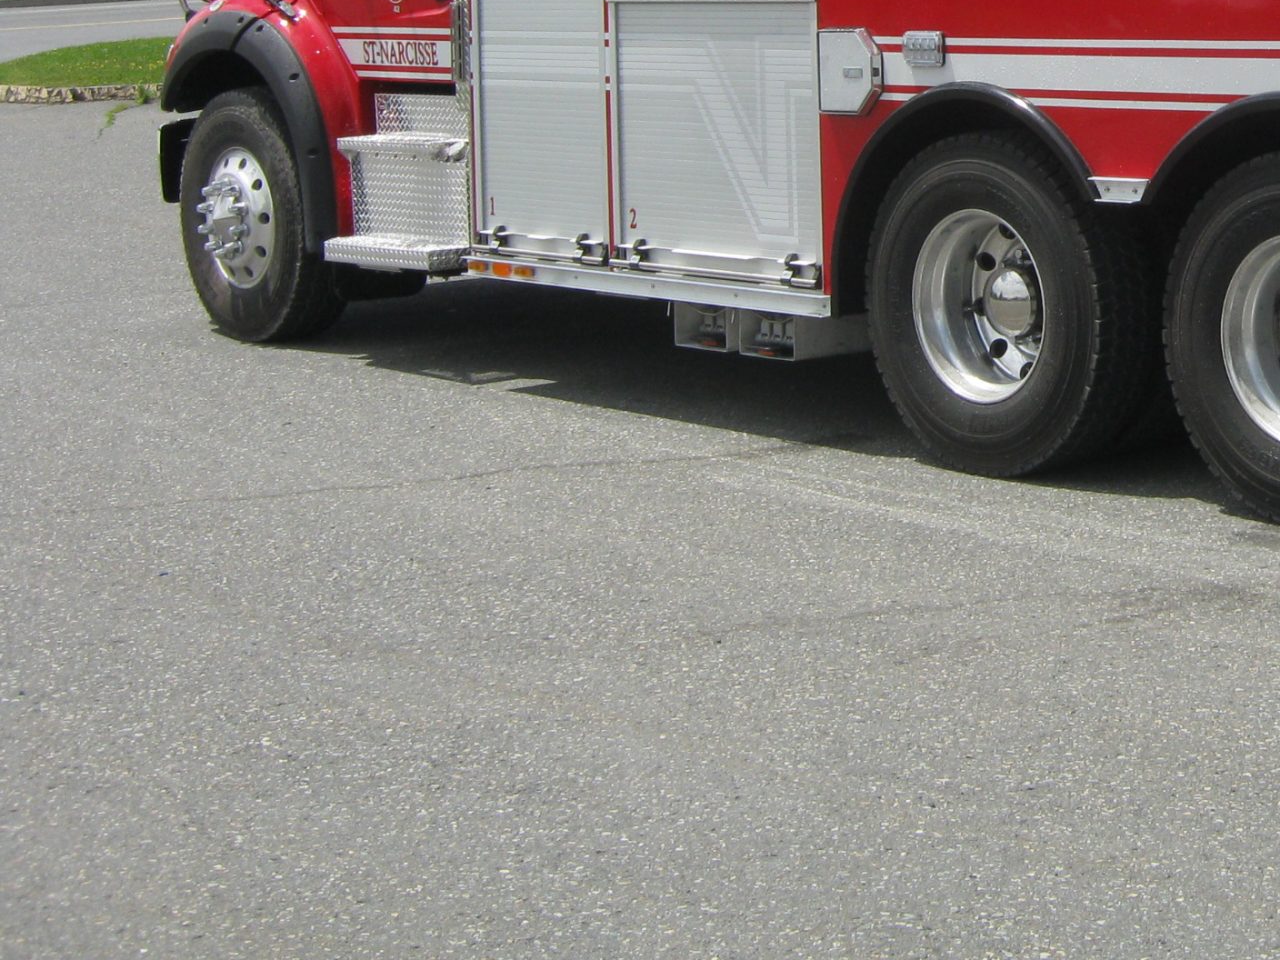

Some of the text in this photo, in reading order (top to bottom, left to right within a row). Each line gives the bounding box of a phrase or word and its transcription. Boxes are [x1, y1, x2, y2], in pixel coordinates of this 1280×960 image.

[362, 40, 439, 66] ST-NARCISSE
[490, 196, 496, 216] 1
[629, 208, 637, 229] 2
